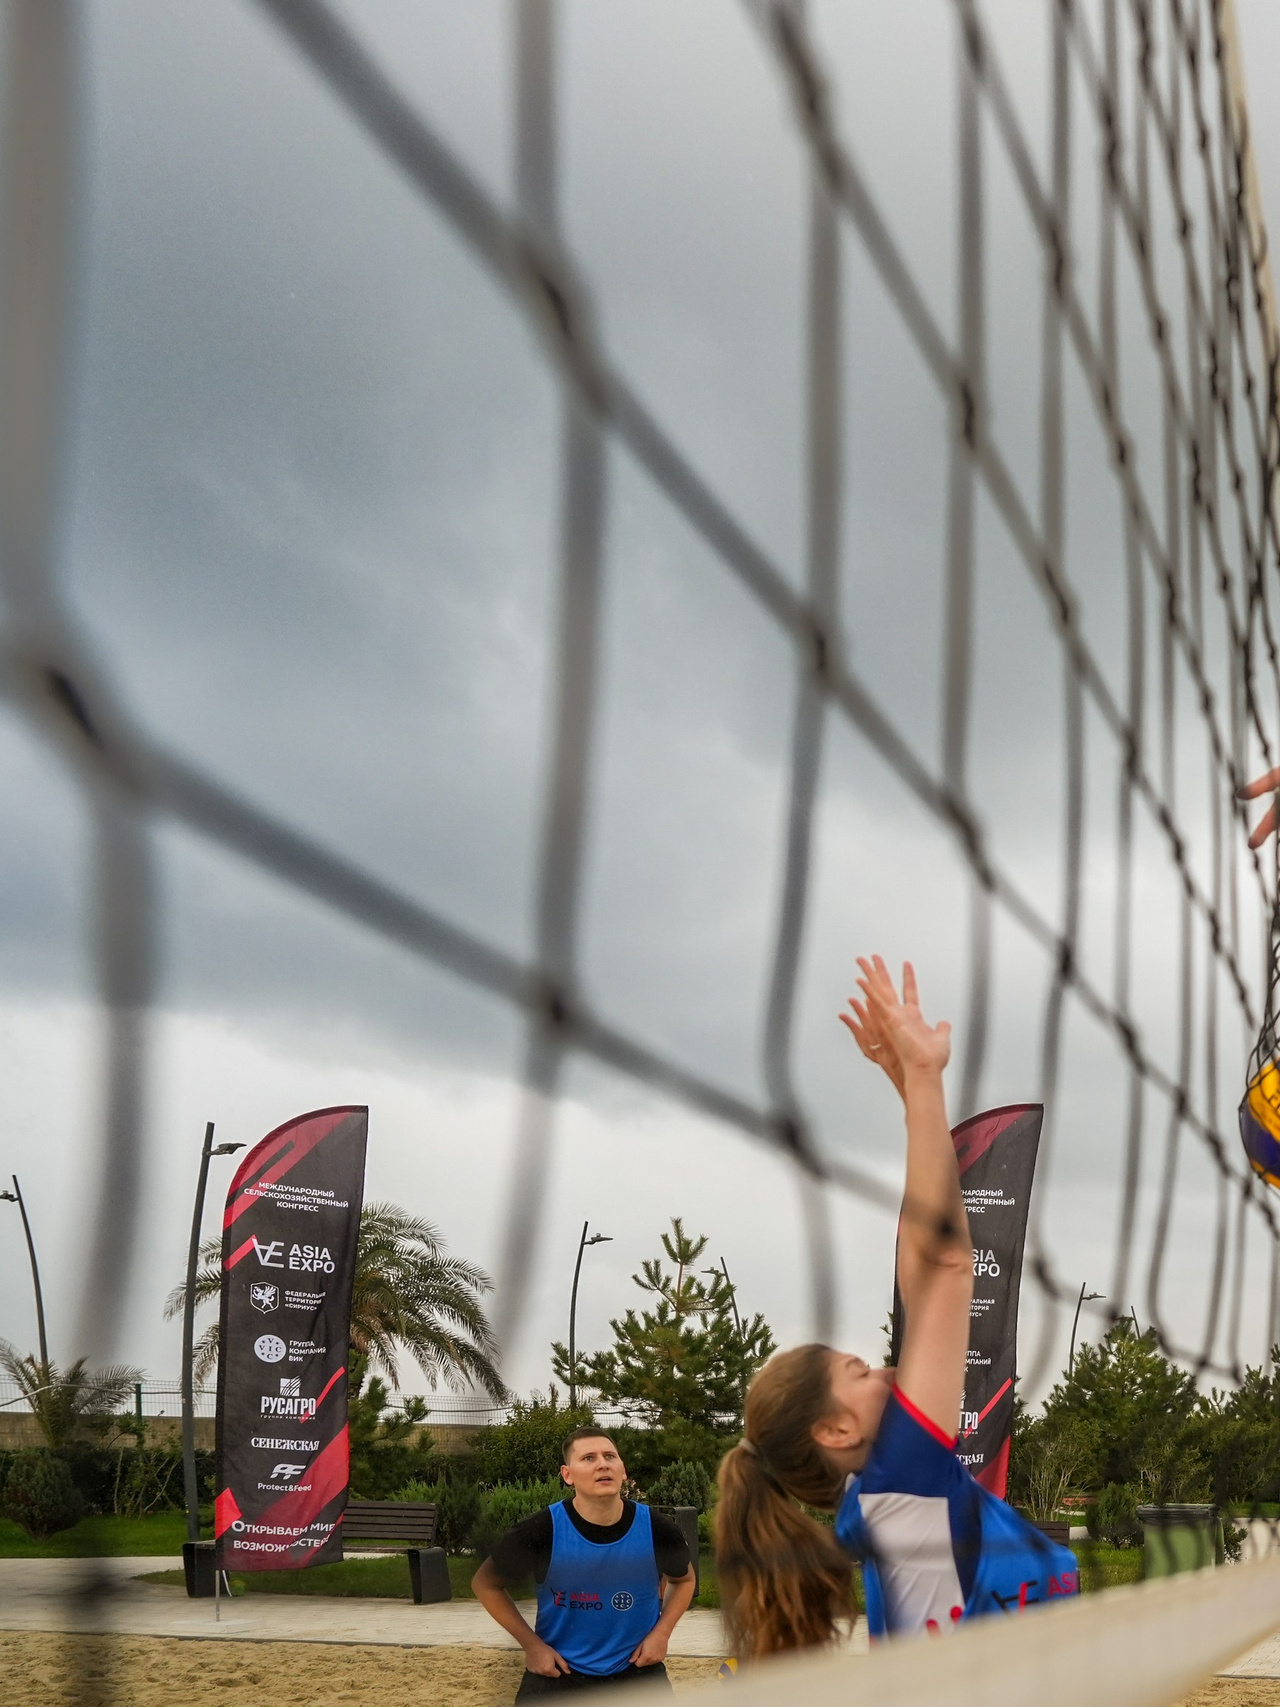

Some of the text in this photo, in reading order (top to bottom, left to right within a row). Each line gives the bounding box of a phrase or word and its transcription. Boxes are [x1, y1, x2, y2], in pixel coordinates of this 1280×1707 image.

[258, 1182, 335, 1198] МЕЖДУНАРОДНЫЙ
[961, 1189, 1003, 1197] НАРОДНЫЙ
[244, 1188, 349, 1208] СЕЛЬСКОХОЗЯЙСТВЕННЫЙ
[276, 1201, 319, 1213] КОНГРЕСС
[289, 1243, 332, 1261] ASIA
[971, 1249, 996, 1262] SIA
[289, 1259, 335, 1274] EXPO
[965, 1357, 992, 1365] МПАНИЙ
[260, 1396, 316, 1415] РУСАГРО
[251, 1437, 320, 1451] СЕНЕЖСКАЯ
[257, 1482, 312, 1492] Protect&Feed
[570, 1592, 600, 1602] ASIA
[570, 1601, 603, 1610] EXPO
